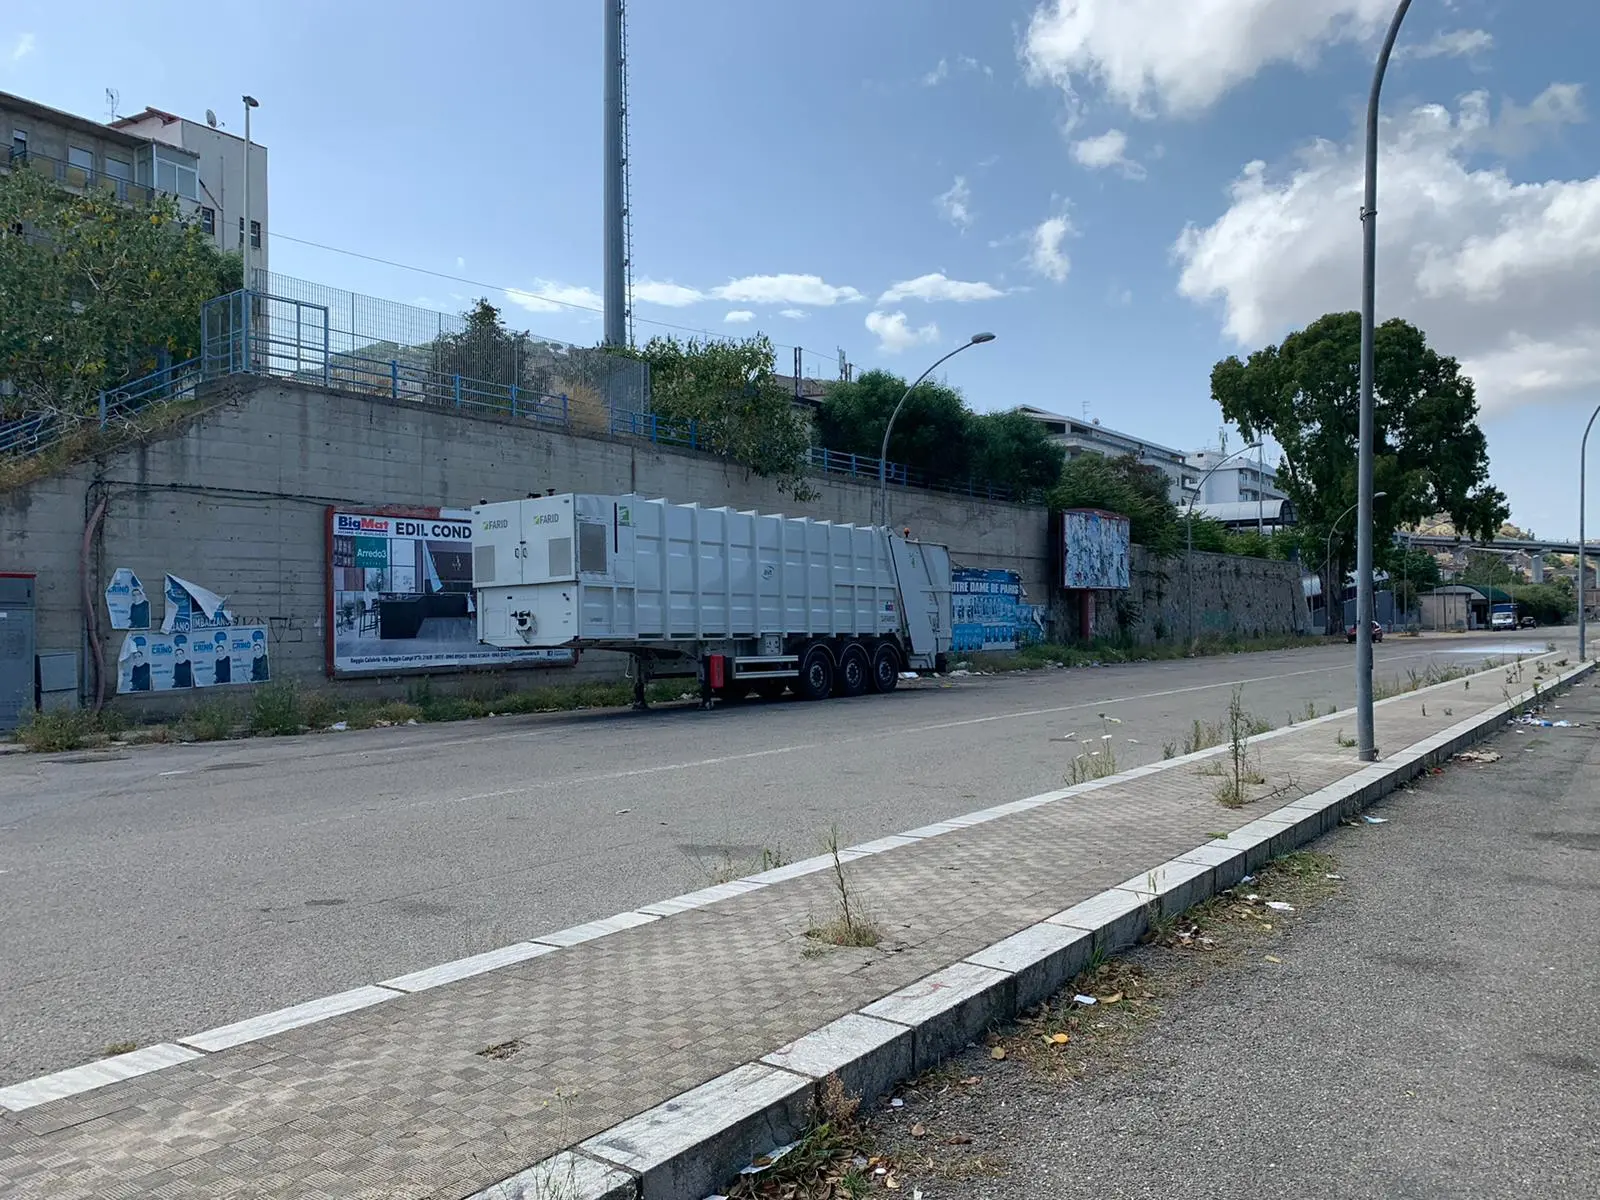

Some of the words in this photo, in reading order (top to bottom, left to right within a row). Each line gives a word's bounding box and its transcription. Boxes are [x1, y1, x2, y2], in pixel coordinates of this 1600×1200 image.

[338, 515, 389, 530] BigMat
[488, 520, 508, 529] FARID
[539, 514, 559, 524] FARID
[396, 521, 428, 537] EDIL
[432, 525, 472, 539] COND
[357, 548, 387, 558] Arredo3
[952, 581, 968, 592] OTRE
[970, 582, 989, 593] DAME
[990, 583, 999, 593] DE
[1000, 584, 1018, 594] PARIS
